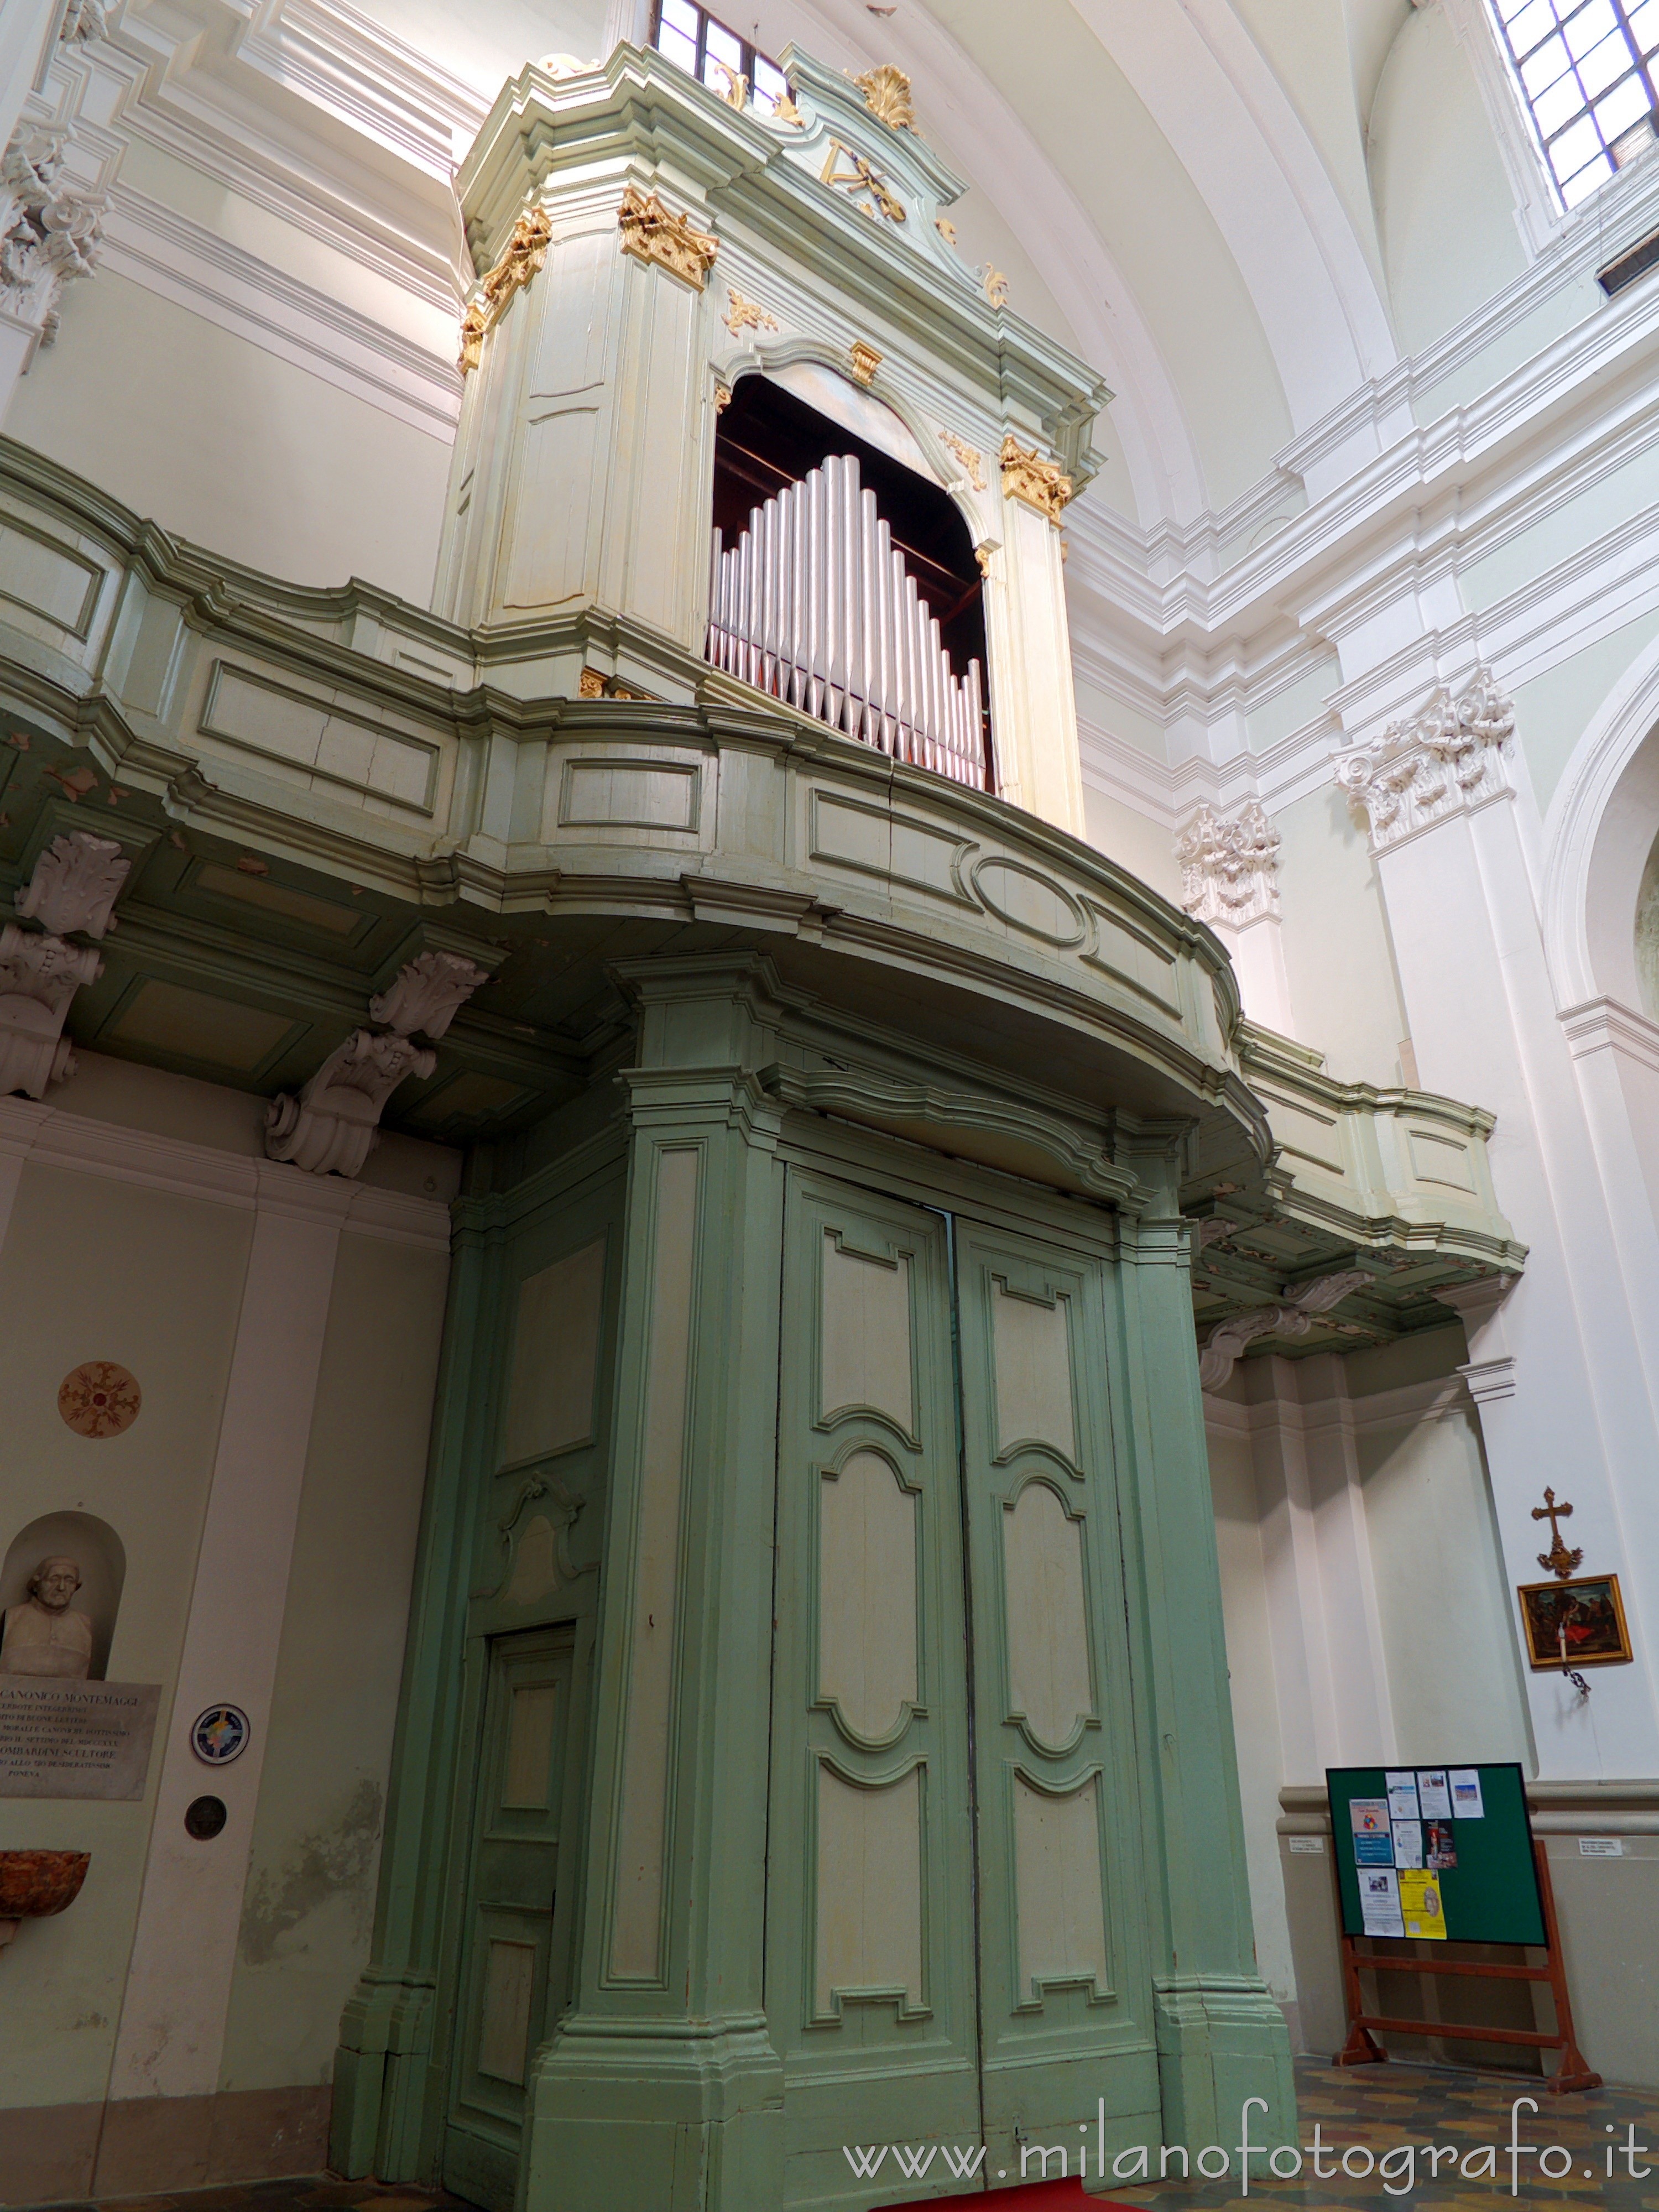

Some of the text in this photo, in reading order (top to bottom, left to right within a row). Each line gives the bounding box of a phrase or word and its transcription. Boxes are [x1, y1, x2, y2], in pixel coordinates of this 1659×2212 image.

[1, 1690, 138, 1707] CANONICO MONTEMAGGI
[62, 1749, 116, 1759] SCULTORE
